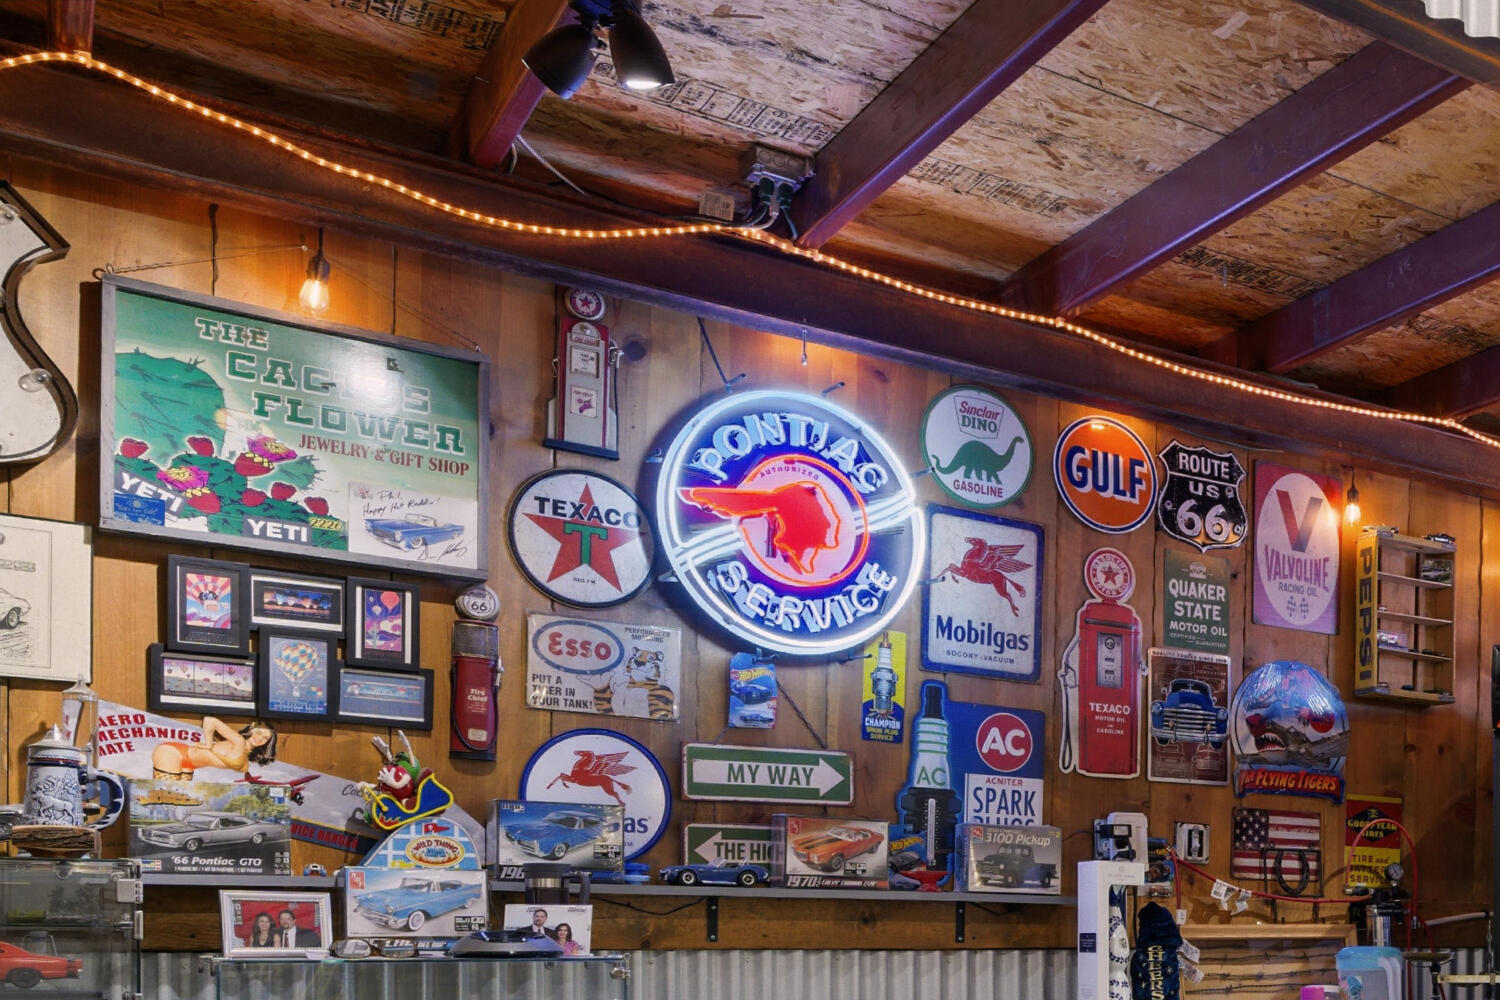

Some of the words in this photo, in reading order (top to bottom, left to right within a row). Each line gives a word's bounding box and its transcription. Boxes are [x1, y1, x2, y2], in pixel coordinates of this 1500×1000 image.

[195, 317, 269, 349] THE
[226, 351, 429, 414] CACS
[959, 400, 1000, 420] Sinclair
[253, 392, 465, 453] FLOWER
[961, 414, 997, 433] DINO
[299, 434, 370, 459] JEWELRY
[389, 450, 424, 468] GIFT
[428, 458, 469, 476] SHOP
[690, 412, 888, 493] PONTIAC
[759, 466, 820, 481] AUTHORIZED
[1065, 445, 1147, 504] GULF
[1178, 453, 1230, 480] ROUTE
[121, 472, 182, 512] YETI
[953, 480, 1003, 498] GASOLINE
[1189, 483, 1220, 498] US
[534, 496, 642, 528] TEXACO
[1177, 499, 1230, 542] 66
[247, 518, 308, 542] YETI
[309, 517, 342, 530] 2226
[564, 522, 608, 567] T
[1264, 544, 1330, 592] VALVOLINE
[709, 561, 897, 632] SERVICE
[1168, 578, 1226, 602] QUAKER
[1278, 581, 1304, 595] RACING
[1307, 586, 1318, 597] OIL
[471, 601, 487, 611] 66
[1174, 601, 1221, 621] STATE
[1360, 547, 1373, 681] PEPSI
[936, 615, 1030, 654] Mobilgas
[1169, 621, 1207, 634] MOTOR
[1211, 625, 1227, 637] OIL
[532, 674, 551, 684] PUT
[556, 676, 562, 684] A
[566, 687, 575, 697] IN
[563, 698, 593, 710] TANK!
[1089, 702, 1130, 715] TEXACO
[99, 713, 146, 727] AERO
[865, 717, 900, 730] CHAMPION
[1095, 715, 1115, 723] MOTOR
[1096, 727, 1124, 735] GASOLINE
[981, 727, 1026, 757] AC
[728, 763, 761, 783] MY
[767, 766, 814, 786] WAY
[916, 767, 947, 786] AC
[985, 777, 1023, 786] ACNITER
[1256, 768, 1295, 788] FLYING
[1298, 771, 1337, 791] TIGERS
[973, 787, 1036, 816] SPARK
[412, 839, 433, 852] WILD
[434, 839, 459, 853] THING
[985, 832, 1013, 843] 3100
[1015, 834, 1051, 847] Pickup
[714, 841, 745, 860] THE
[1352, 854, 1373, 863] TIRE
[192, 857, 234, 866] Pontiac
[240, 858, 262, 866] GTO
[1147, 945, 1164, 1000] CHEERS
